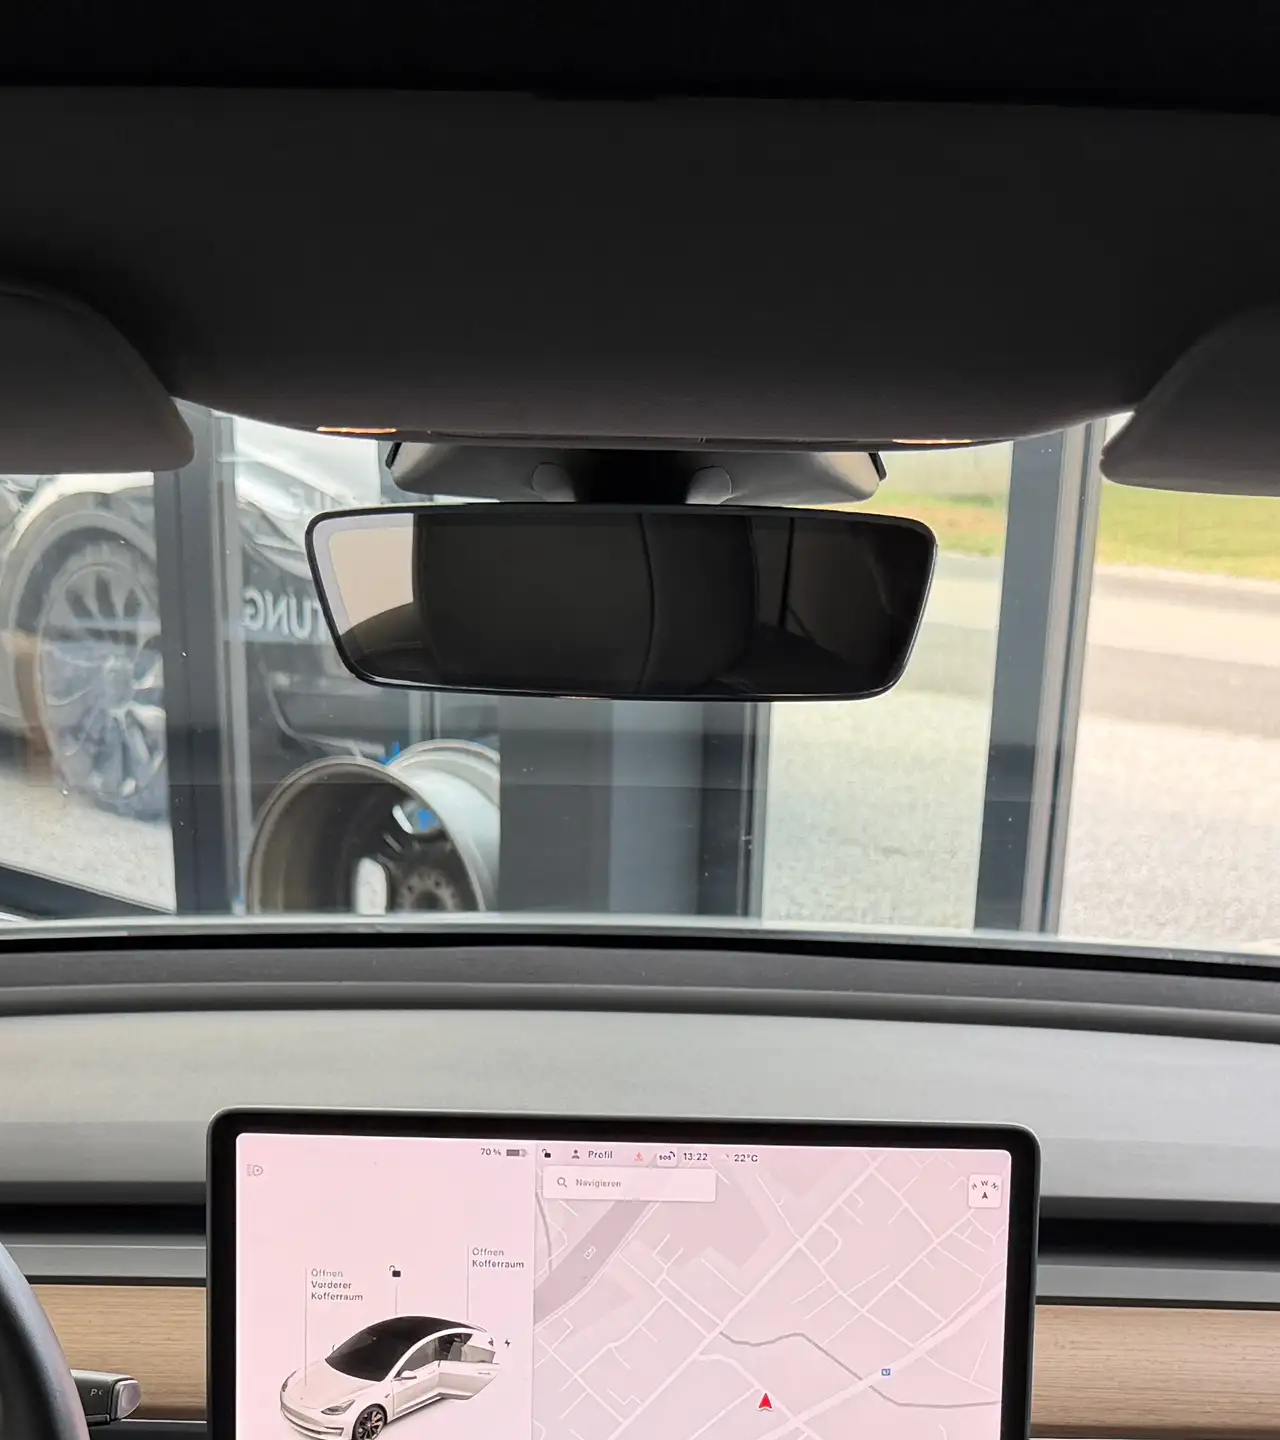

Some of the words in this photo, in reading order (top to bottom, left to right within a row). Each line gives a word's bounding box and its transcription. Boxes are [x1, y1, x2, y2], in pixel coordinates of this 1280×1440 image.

[480, 1147, 492, 1156] 70
[493, 1147, 502, 1156] %
[587, 1150, 613, 1160] Profil
[683, 1152, 708, 1161] 13:22
[733, 1153, 758, 1163] 22°C
[575, 1178, 621, 1188] Navigieren
[472, 1247, 504, 1257] Öffnen
[472, 1259, 525, 1269] Kofferraum
[311, 1268, 344, 1278] Öffnen
[311, 1281, 352, 1289] Vorderer
[311, 1292, 363, 1301] Kofferraum
